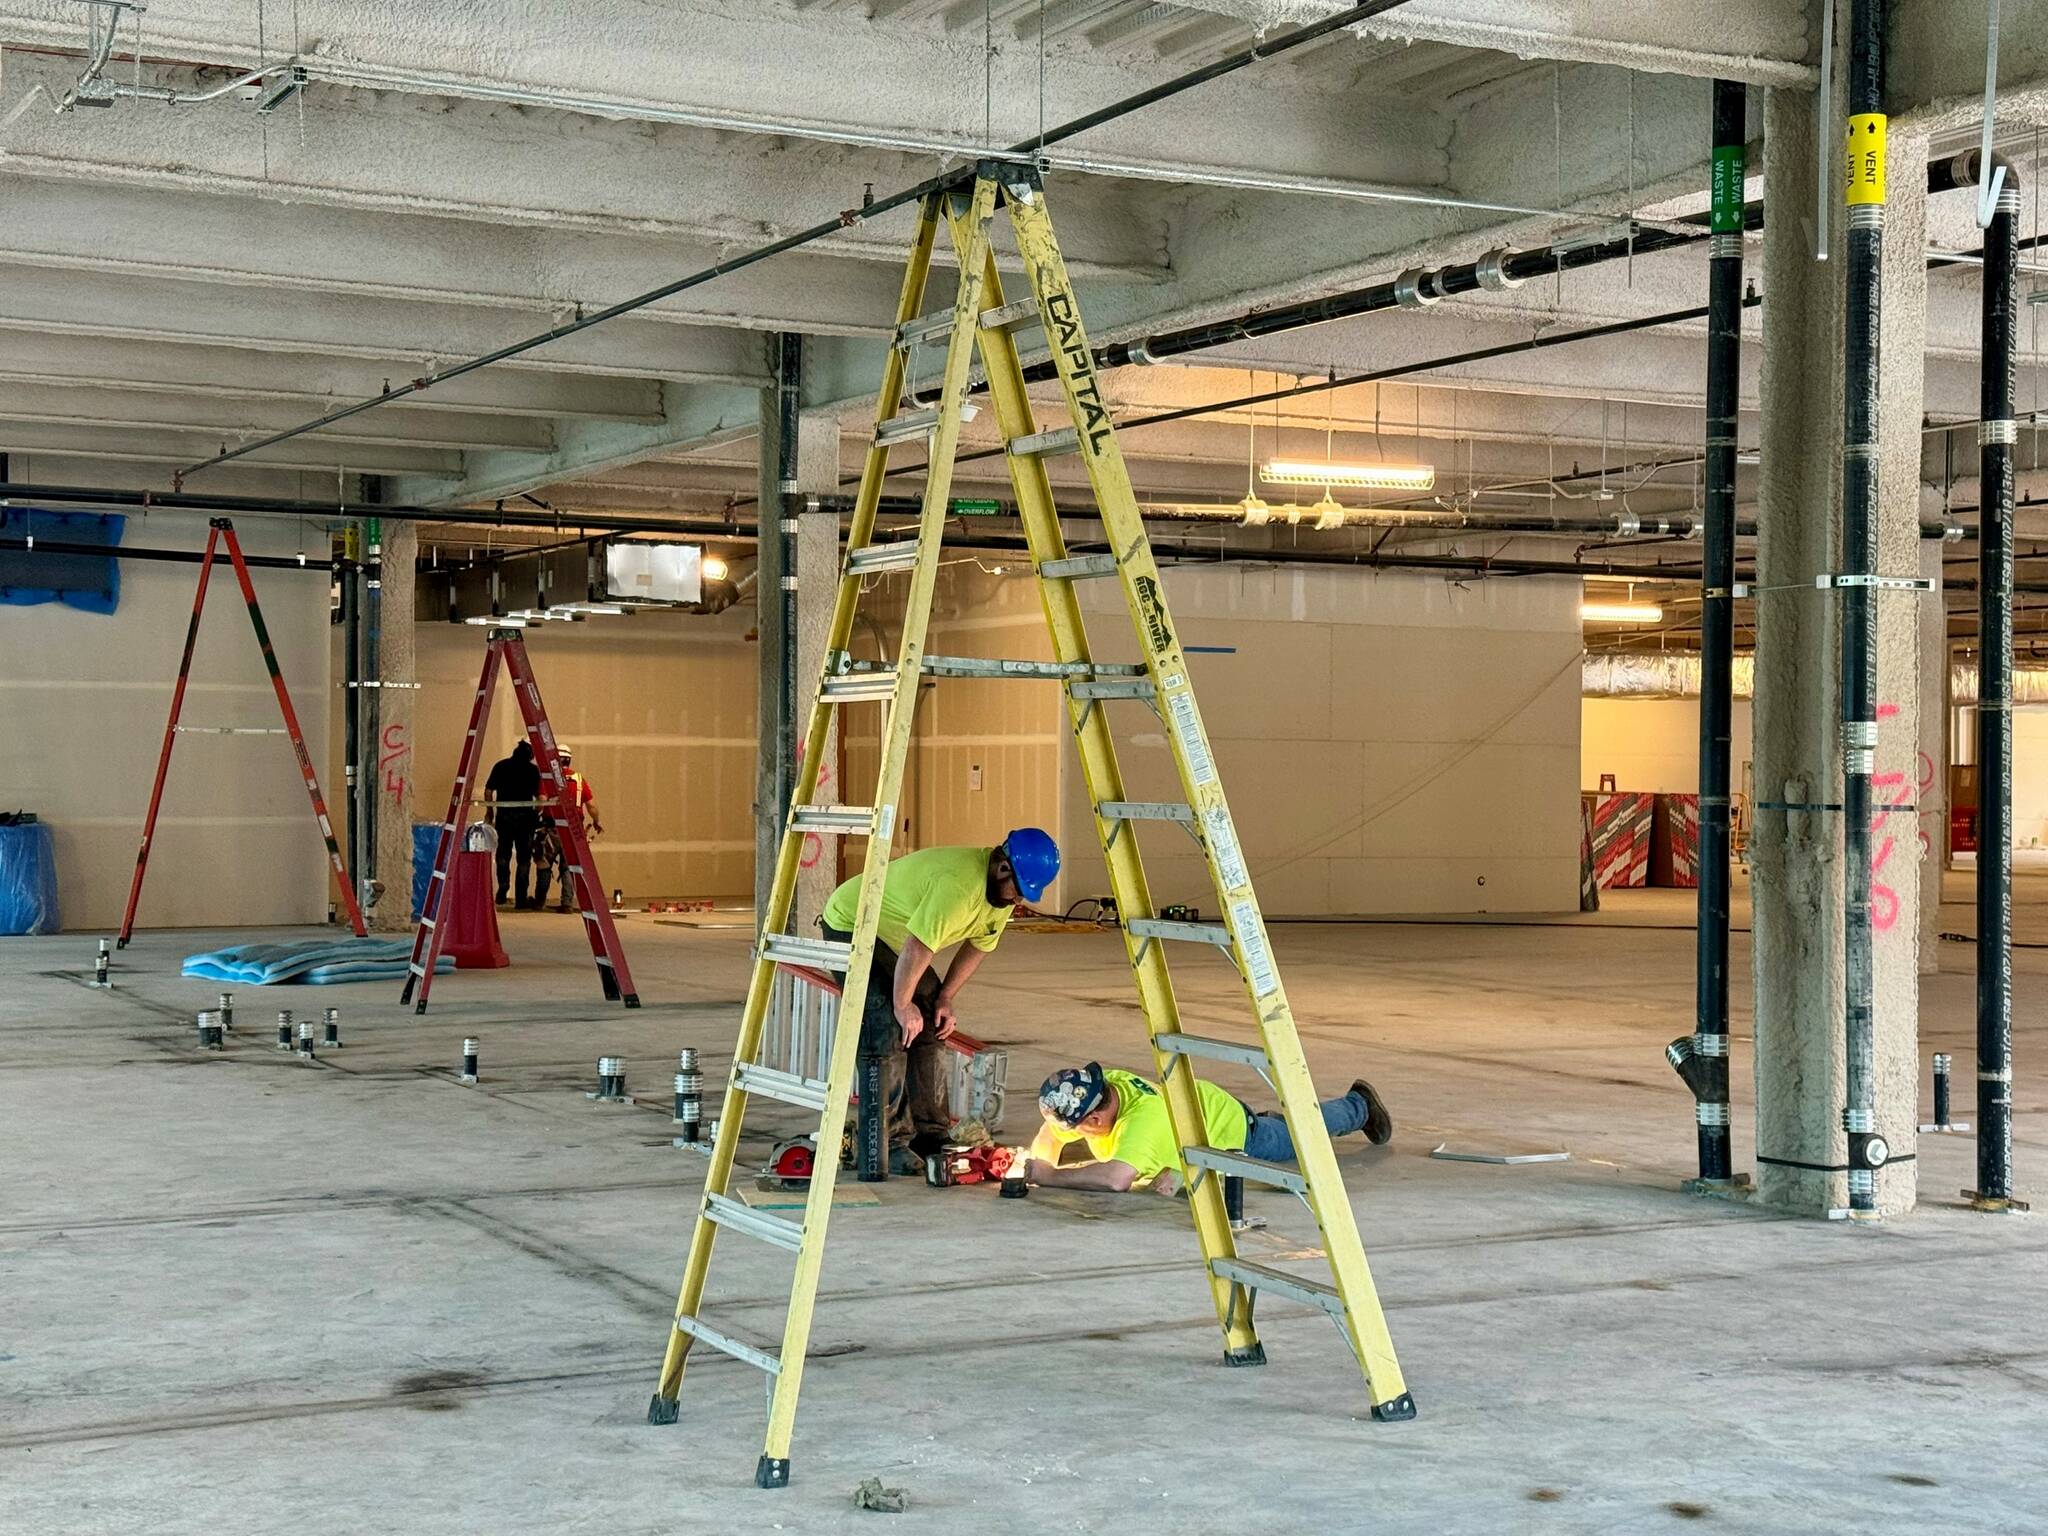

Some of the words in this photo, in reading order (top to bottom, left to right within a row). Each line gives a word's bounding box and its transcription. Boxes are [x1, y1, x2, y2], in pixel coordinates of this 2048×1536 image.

[1713, 159, 1725, 205] WASTE
[1731, 159, 1743, 204] WASTE
[1865, 150, 1877, 185] VENT
[1047, 294, 1111, 457] CAPITAL
[1148, 614, 1166, 654] RIVER
